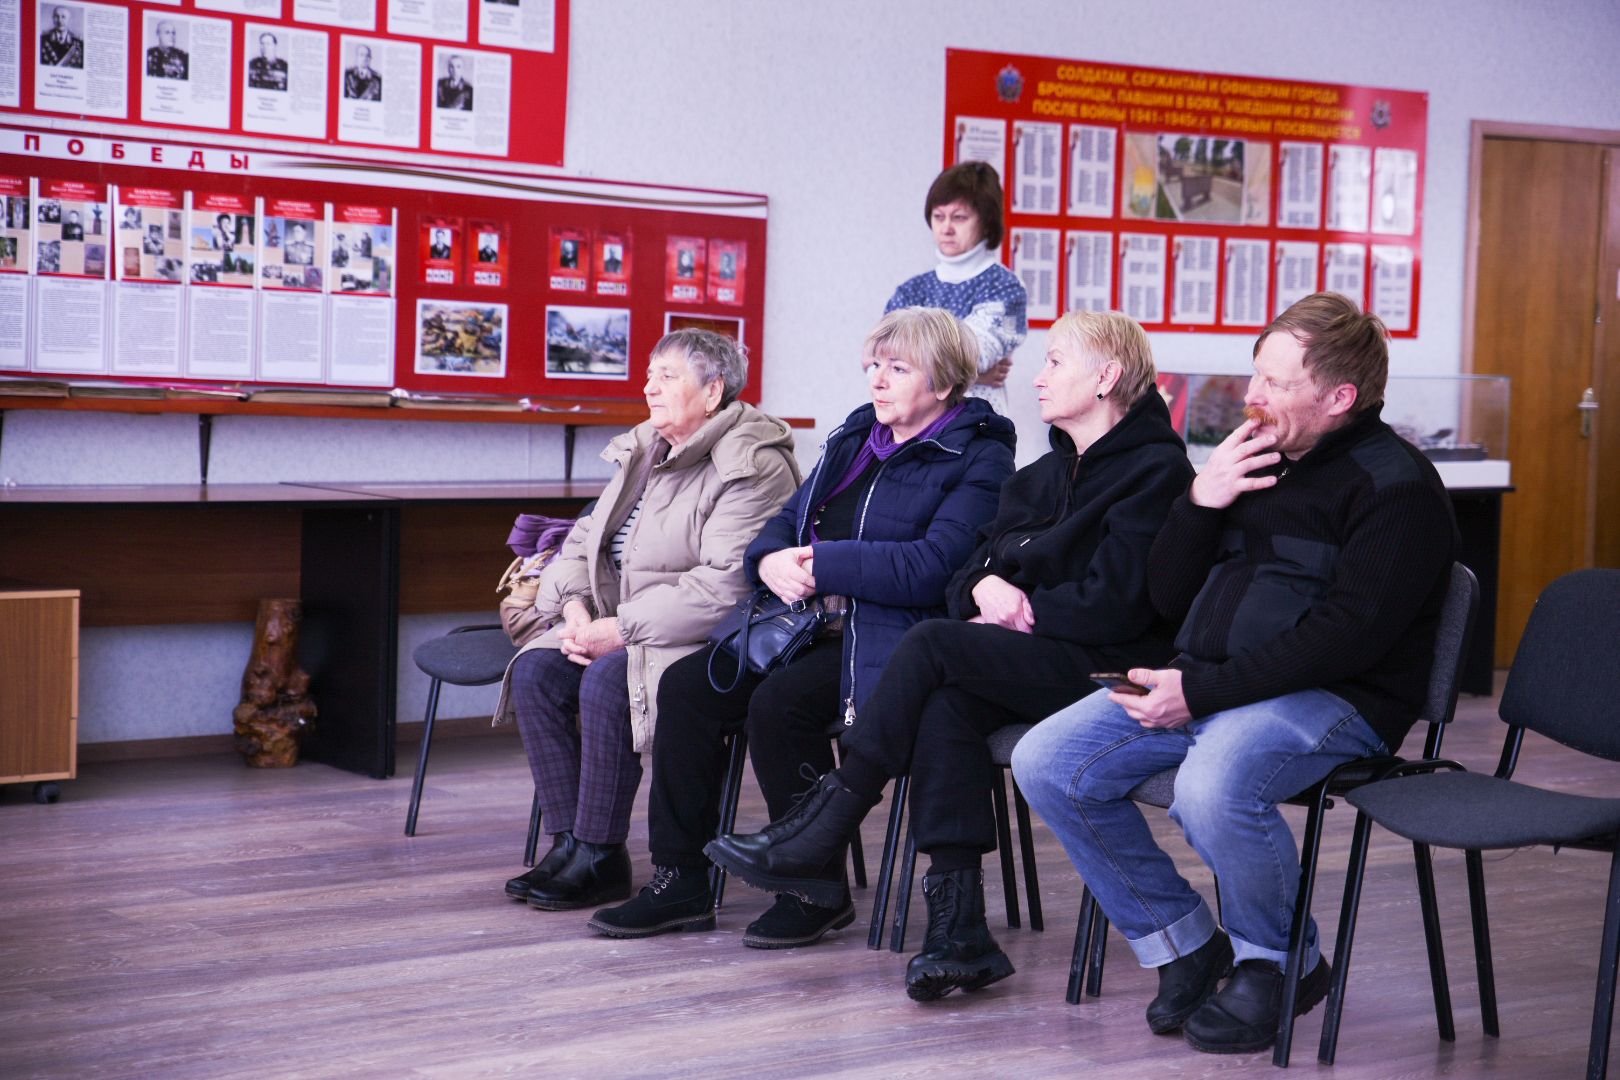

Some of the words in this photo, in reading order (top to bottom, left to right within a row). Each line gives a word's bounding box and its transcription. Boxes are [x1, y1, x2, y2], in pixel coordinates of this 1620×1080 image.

[1132, 71, 1207, 92] СЕРЖАНТАМ
[1209, 79, 1219, 93] И
[1032, 99, 1078, 118] ПОСЛЕ
[24, 134, 249, 170] ПОБЕДЫ
